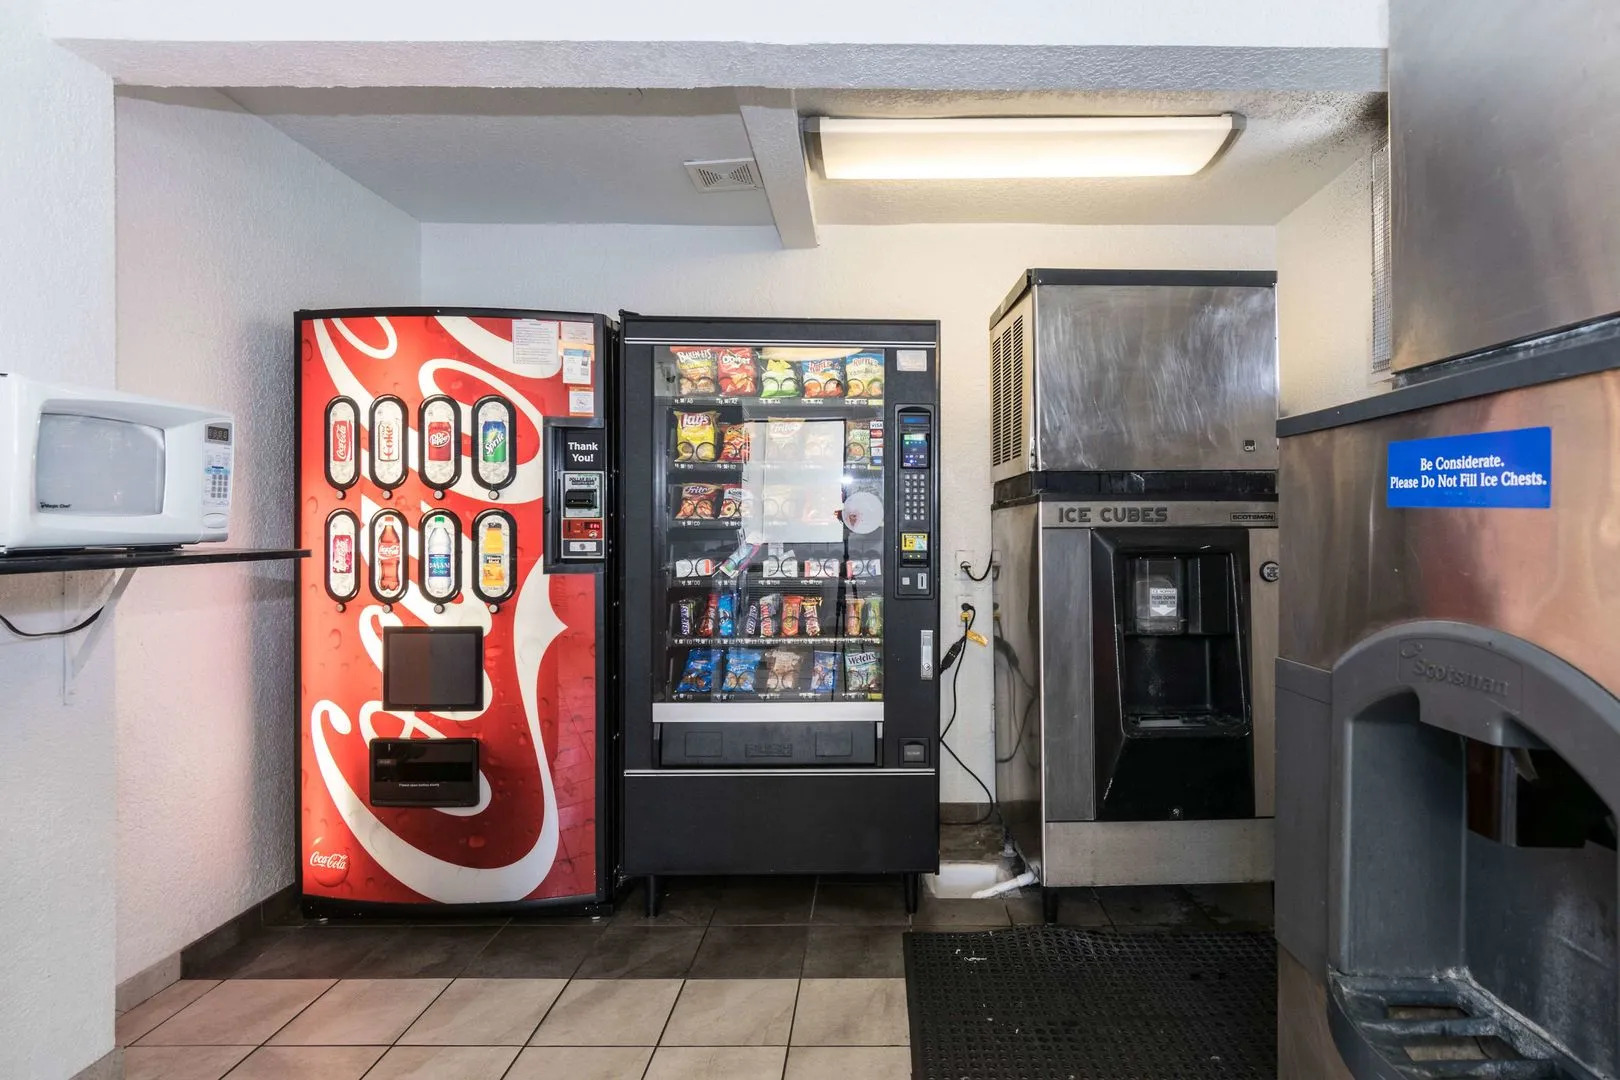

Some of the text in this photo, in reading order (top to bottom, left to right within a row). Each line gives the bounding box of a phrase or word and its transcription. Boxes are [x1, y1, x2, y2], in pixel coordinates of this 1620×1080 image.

[485, 432, 504, 455] Sprite
[568, 441, 599, 451] Thank
[571, 453, 594, 462] You!
[1420, 454, 1505, 471] Be Considerate.
[1390, 471, 1547, 489] Please Do Not Fill Ice Chests.
[1059, 507, 1168, 523] ICE CUBES
[848, 653, 876, 665] Welch's
[1413, 659, 1509, 697] Scotsman
[310, 851, 348, 869] Coca-Cola
